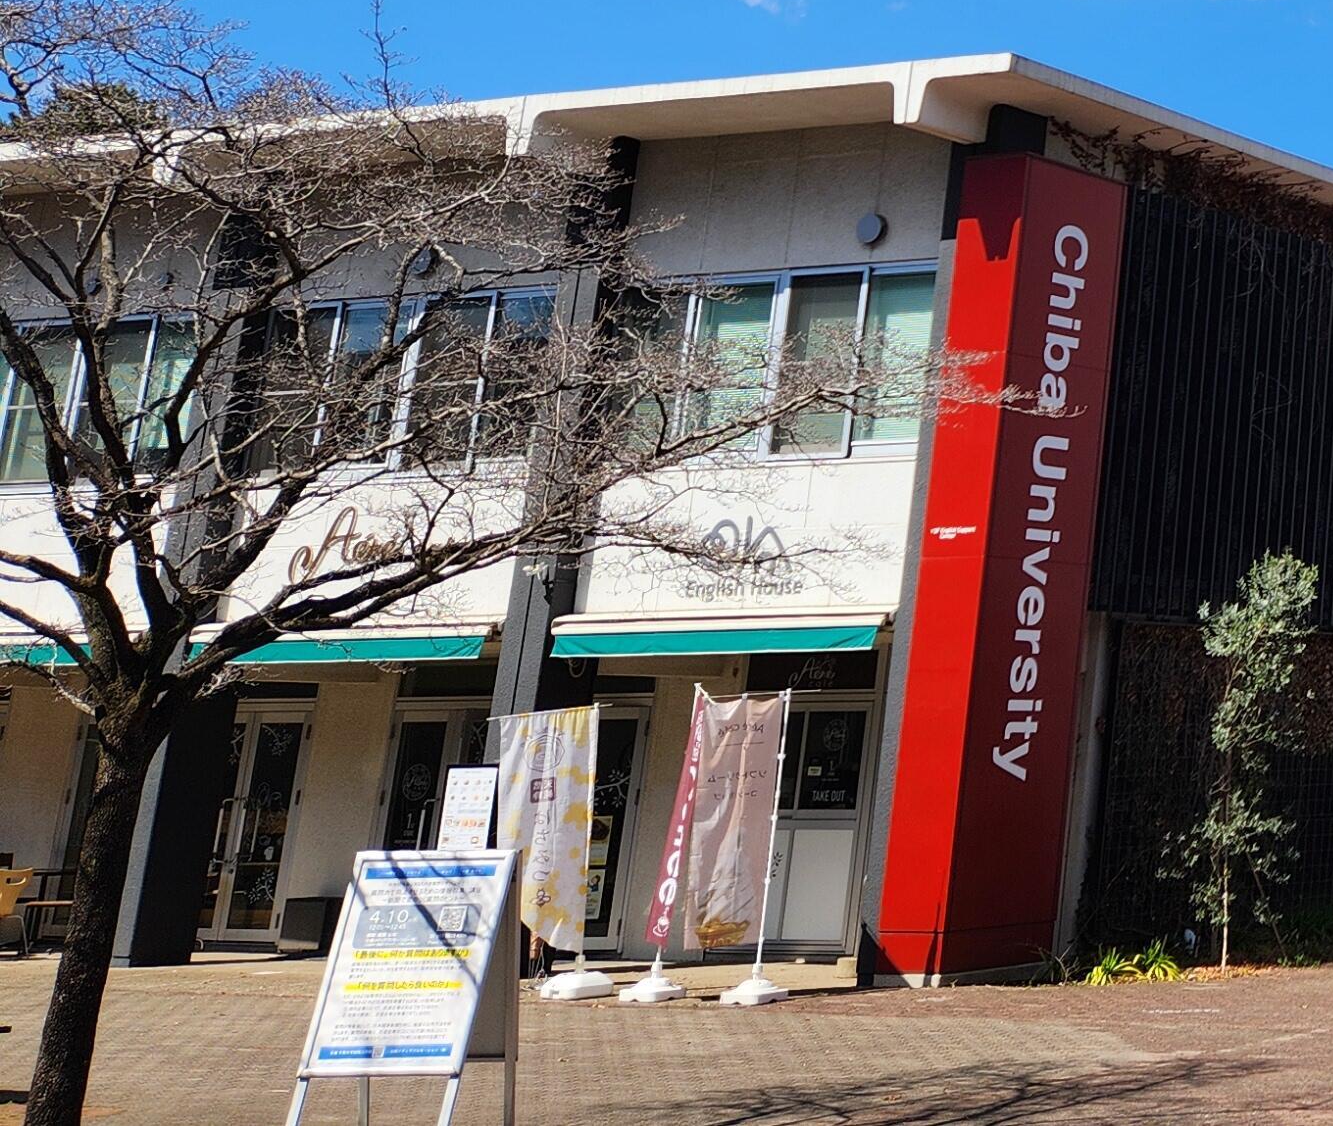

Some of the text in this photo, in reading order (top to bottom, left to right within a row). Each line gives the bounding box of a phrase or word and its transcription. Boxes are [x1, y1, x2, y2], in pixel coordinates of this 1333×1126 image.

[992, 224, 1090, 782] Chiba University
[685, 579, 804, 602] English House
[811, 789, 847, 802] TAKE OUT
[369, 909, 409, 924] 4.10
